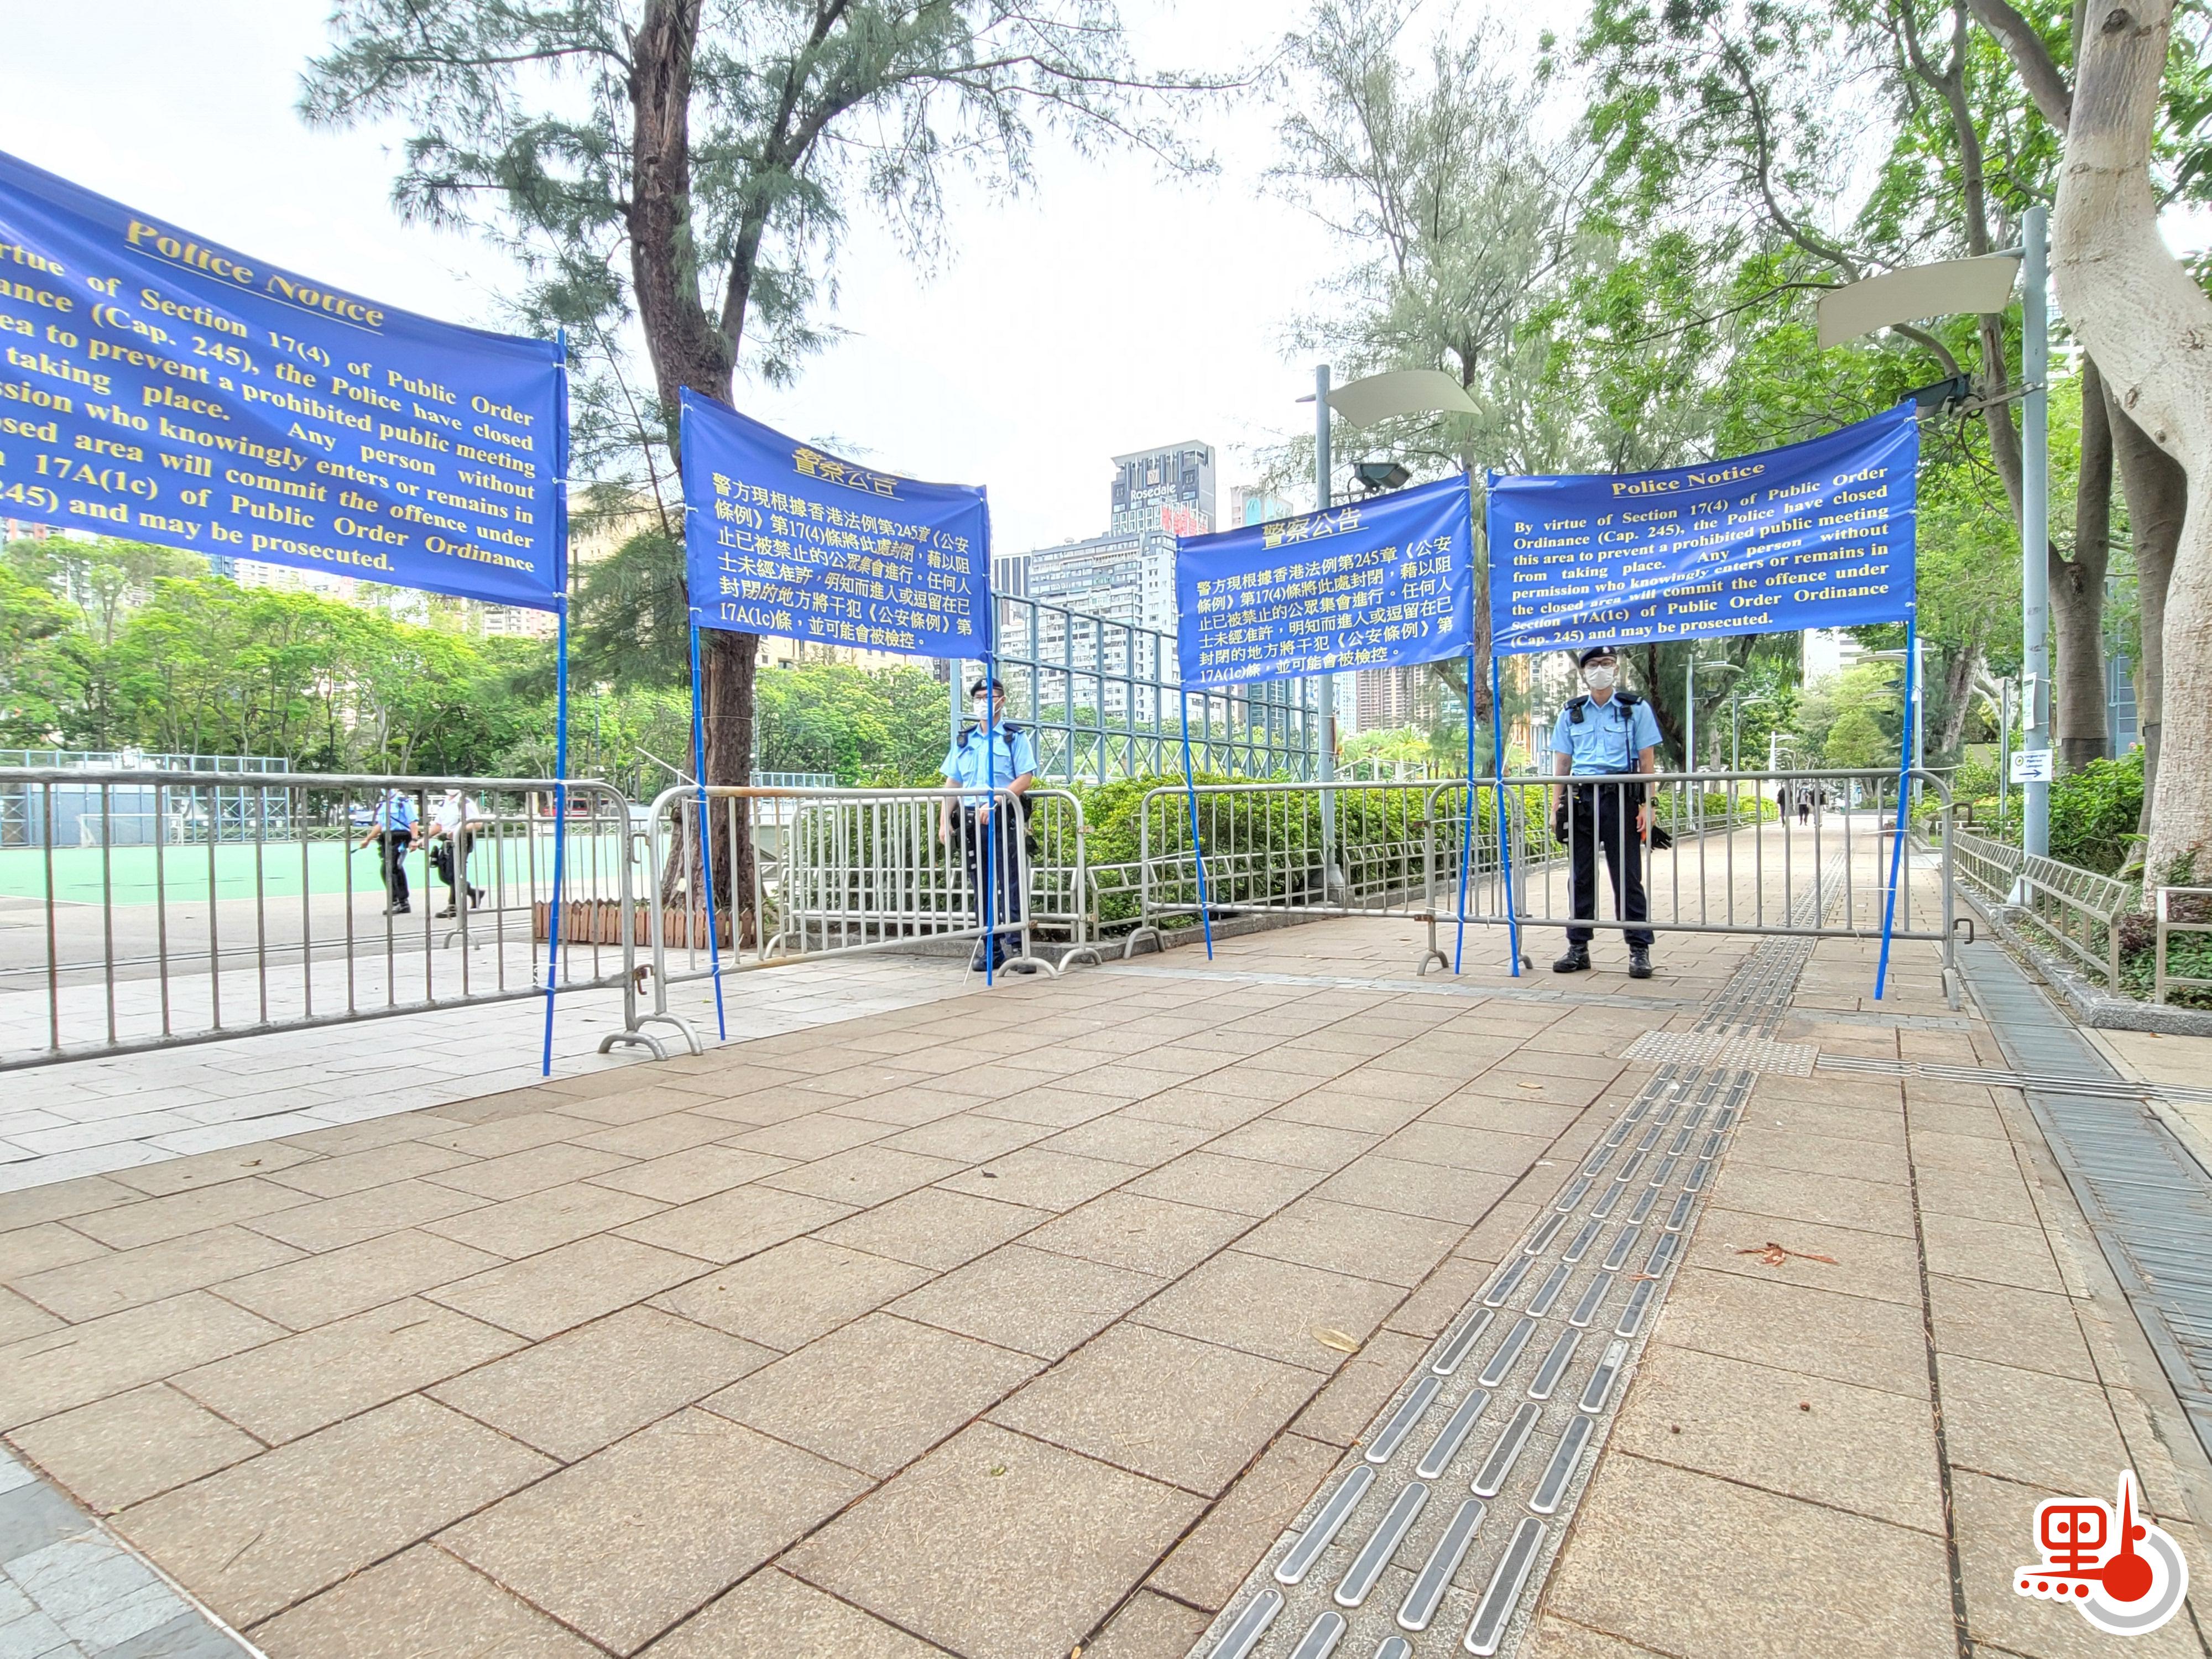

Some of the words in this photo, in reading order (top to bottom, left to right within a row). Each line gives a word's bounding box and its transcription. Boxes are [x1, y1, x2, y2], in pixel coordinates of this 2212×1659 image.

[127, 220, 254, 284] Police
[266, 275, 384, 327] Notice
[86, 276, 122, 298] of
[140, 289, 248, 338] Section
[268, 331, 331, 367] 17(4)
[347, 362, 372, 379] of
[387, 369, 456, 405] Public
[471, 395, 534, 426] Order
[91, 303, 177, 346] (Cap.
[192, 336, 260, 375] 245),
[275, 363, 316, 388] the
[331, 377, 401, 412] Police
[413, 402, 462, 430] have
[473, 424, 534, 451] closed
[6, 347, 111, 395] taking
[143, 386, 231, 421] place.
[287, 422, 337, 452] Any
[360, 445, 436, 476] person
[457, 470, 535, 499] without
[46, 325, 78, 348] to
[88, 338, 210, 384] prevent
[218, 377, 234, 392] a
[242, 384, 372, 432] prohibited
[380, 423, 450, 453] public
[456, 443, 536, 479] meeting
[0, 382, 72, 413] sion
[84, 403, 149, 431] who
[159, 417, 308, 472] knowingly
[316, 461, 390, 489] enters
[395, 482, 420, 497] or
[426, 489, 508, 518] remains
[515, 506, 534, 524] in
[0, 418, 58, 443] sed
[74, 435, 143, 462] area
[159, 453, 212, 477] will
[225, 469, 327, 502] commit
[339, 491, 379, 513] the
[389, 504, 467, 533] offence
[476, 526, 534, 549] under
[1613, 479, 1680, 495] Police
[1688, 465, 1765, 487] Notice
[35, 454, 159, 500] 17A(1c)
[180, 488, 213, 508] of
[231, 494, 315, 528] Public
[333, 517, 410, 546] Order
[425, 536, 535, 572] Ordinance
[1130, 483, 1176, 501] Rosedale
[1513, 536, 1590, 549] Ordinance
[1598, 531, 1639, 545] (Cap.
[1647, 524, 1685, 538] 245),
[1693, 519, 1718, 531] the
[1727, 509, 1775, 525] Police
[1784, 498, 1823, 514] have
[1833, 484, 1888, 505] closed
[1515, 521, 1533, 535] By
[1543, 519, 1587, 531] virtue
[1597, 513, 1614, 526] of
[1622, 509, 1678, 524] Section
[1691, 499, 1729, 515] 17(4)
[1740, 493, 1758, 506] of
[1768, 482, 1820, 501] Public
[1832, 467, 1888, 486] Order
[0, 480, 59, 513] 45)
[69, 499, 129, 523] and
[139, 513, 202, 539] may
[211, 521, 243, 544] be
[252, 534, 395, 571] prosecuted.
[1262, 508, 1362, 547] 警察公告
[1513, 554, 1539, 566] this
[1543, 554, 1574, 564] area
[1579, 551, 1594, 561] to
[1598, 544, 1655, 562] prevent
[1658, 544, 1668, 552] a
[1673, 528, 1754, 553] prohibited
[1759, 518, 1812, 539] public
[1818, 507, 1890, 526] meeting
[1513, 571, 1547, 583] from
[1561, 566, 1608, 579] taking
[1623, 561, 1666, 576] place.
[1697, 550, 1729, 563] Any
[1746, 539, 1802, 557] person
[1819, 524, 1889, 542] without
[1512, 584, 1590, 602] permission
[1595, 581, 1625, 592] who
[1630, 569, 1709, 589] knowingly
[1714, 560, 1764, 574] enters
[1769, 556, 1789, 567] or
[1794, 547, 1865, 565] remains
[1871, 543, 1888, 556] in
[1512, 604, 1534, 615] the
[1541, 601, 1584, 613] closed
[1590, 597, 1621, 608] area
[1629, 589, 1656, 602] will
[1663, 581, 1724, 597] commit
[1732, 578, 1757, 590] the
[1765, 572, 1827, 586] offence
[1835, 564, 1890, 579] under
[1511, 618, 1561, 631] Section
[1572, 609, 1630, 625] 17A(1c)
[1640, 605, 1658, 617] of
[1667, 599, 1718, 614] Public
[1729, 594, 1783, 608] Order
[1794, 585, 1889, 602] Ordinance
[1511, 635, 1549, 649] (Cap.
[1552, 630, 1584, 643] 245)
[1588, 627, 1616, 640] and
[1620, 626, 1652, 638] may
[1657, 622, 1676, 633] be
[1680, 612, 1773, 635] prosecuted.
